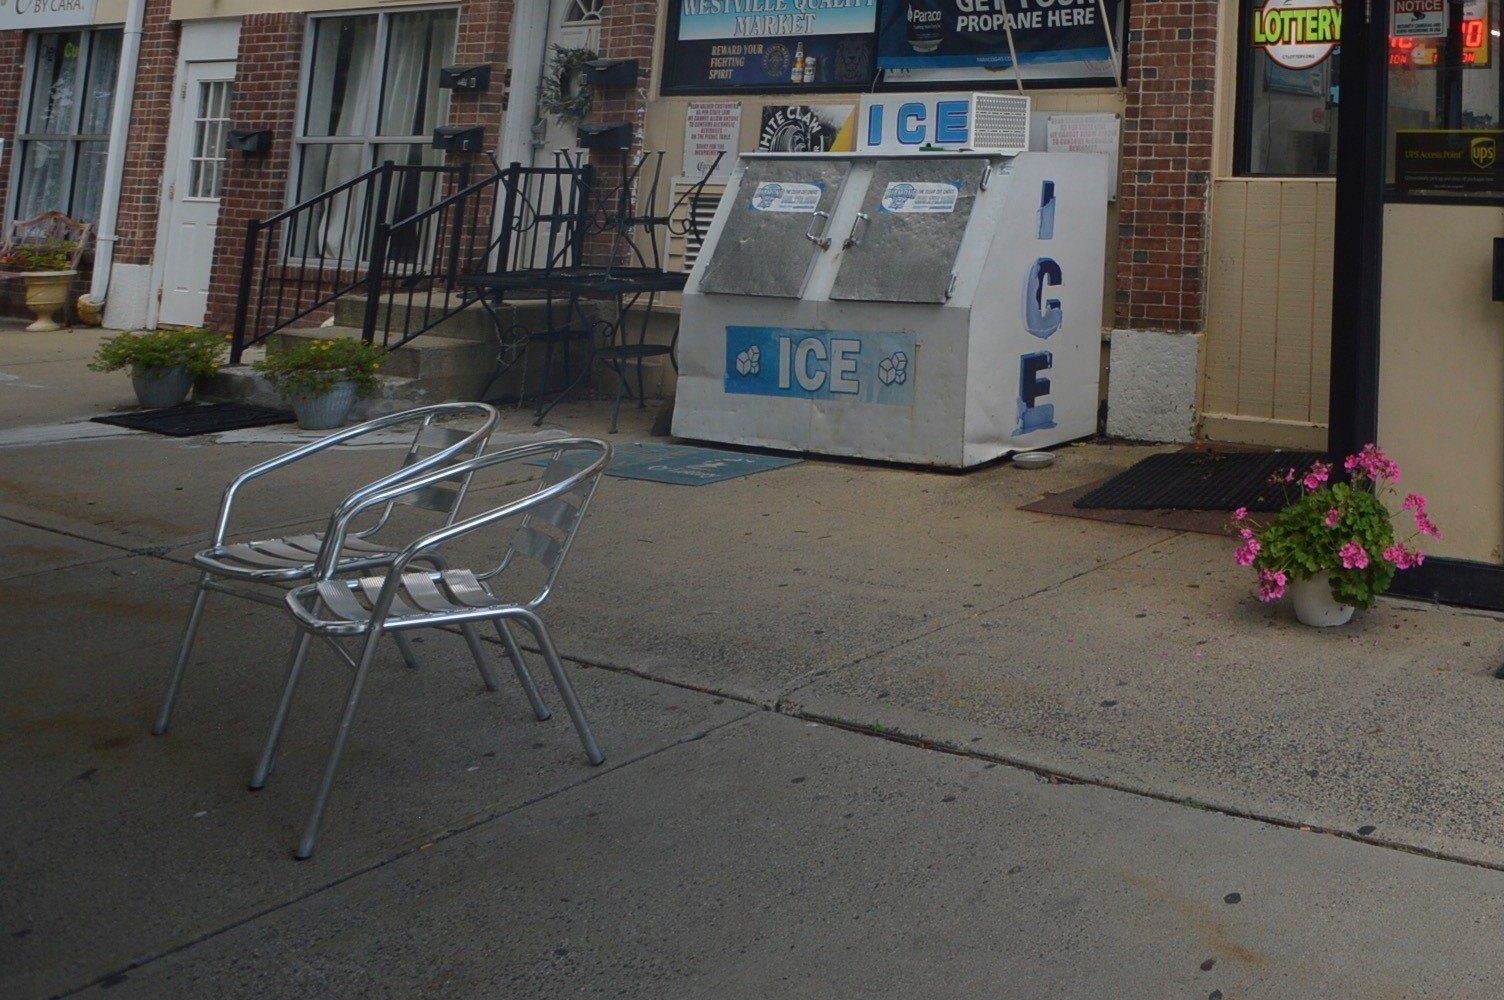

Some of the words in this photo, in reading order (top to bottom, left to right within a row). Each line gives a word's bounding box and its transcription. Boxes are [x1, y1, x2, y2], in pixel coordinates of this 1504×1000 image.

[33, 0, 48, 14] BY
[913, 10, 941, 22] Paraco
[1396, 0, 1442, 12] NOTICE
[733, 13, 816, 37] MARKET
[956, 10, 1042, 32] PROPANE
[1047, 7, 1095, 28] HERE
[1253, 8, 1342, 44] LOTTERY
[711, 45, 742, 56] REWARD
[743, 44, 764, 55] YOUR
[710, 57, 746, 68] FIGHTING
[709, 69, 733, 80] SPIRIT
[786, 106, 822, 134] CLAW
[868, 100, 970, 146] ICE
[1473, 147, 1494, 163] ups
[1011, 180, 1063, 437] ICE
[778, 335, 862, 394] ICE
